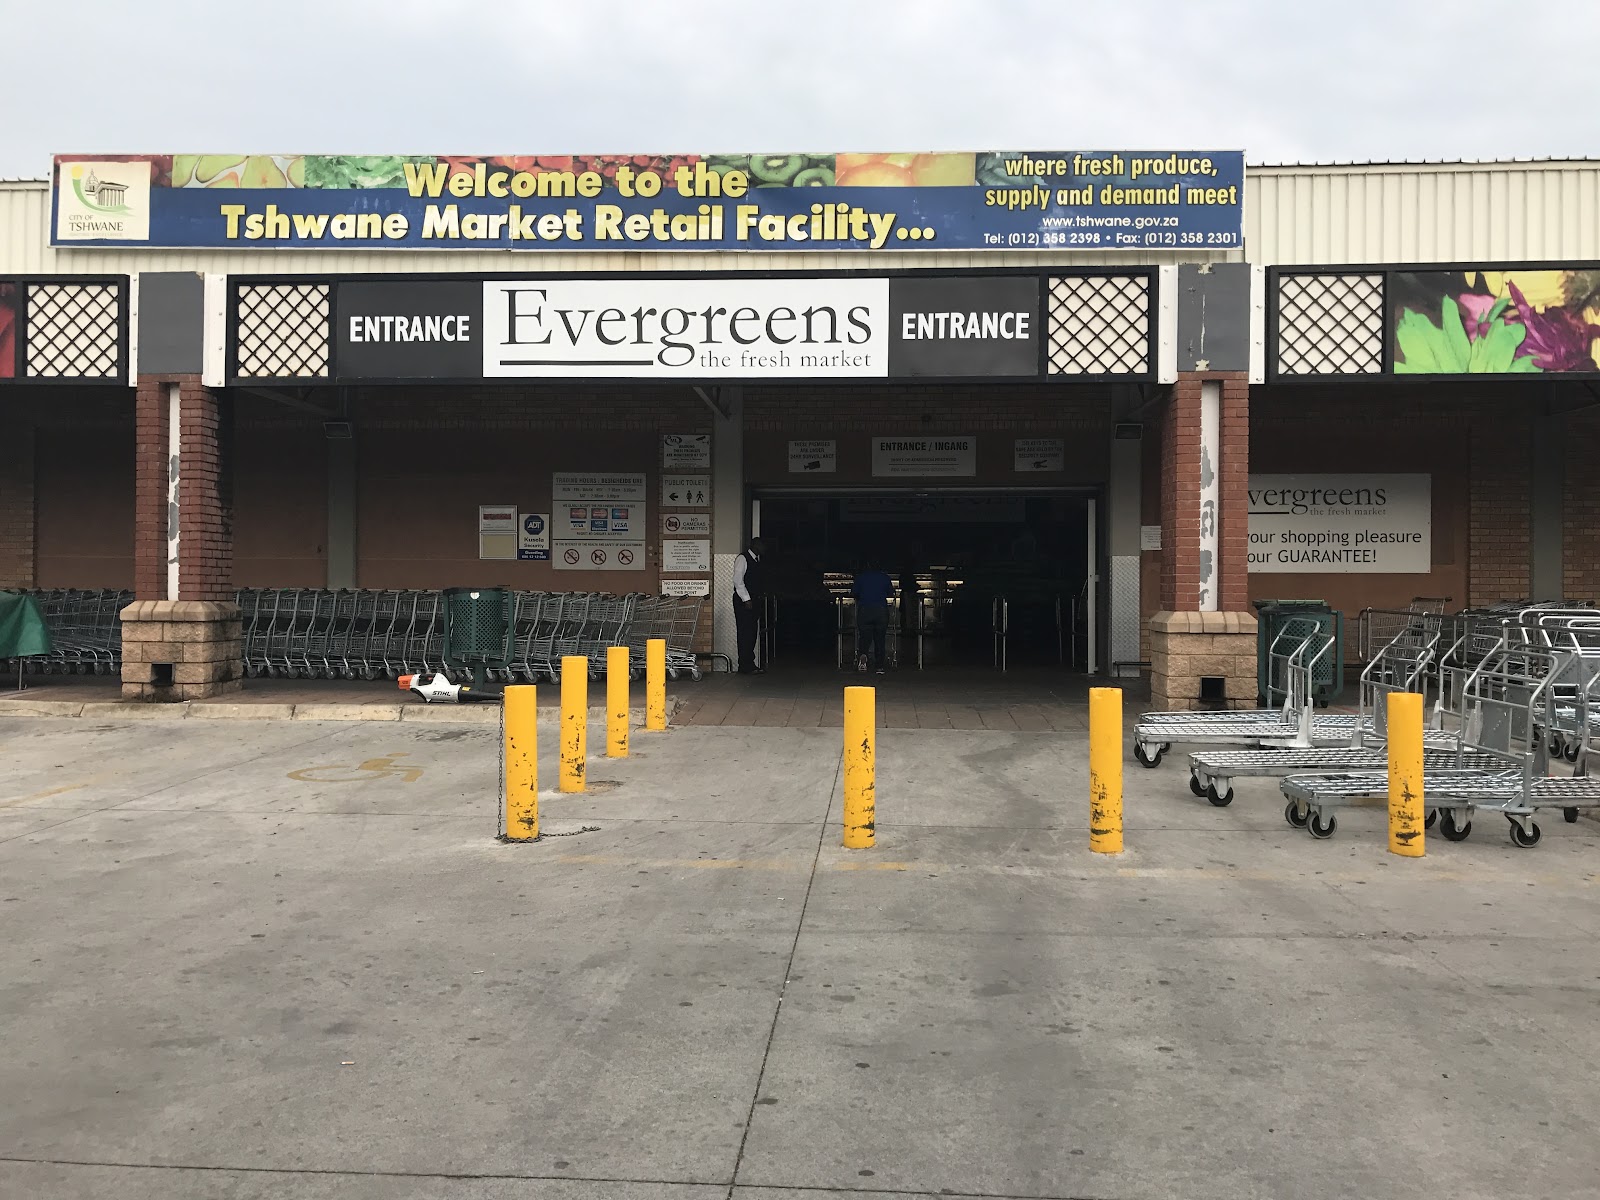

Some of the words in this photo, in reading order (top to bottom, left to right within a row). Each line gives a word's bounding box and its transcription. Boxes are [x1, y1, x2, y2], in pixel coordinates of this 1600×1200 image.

[1005, 155, 1067, 176] where
[1073, 154, 1125, 176] fresh
[1131, 155, 1218, 180] produce,
[403, 162, 603, 198] Welcome
[616, 166, 662, 198] to
[674, 161, 748, 198] the
[985, 184, 1051, 210] supply
[1056, 184, 1093, 206] and
[1100, 184, 1180, 205] demand
[1187, 184, 1237, 205] meet
[68, 222, 124, 232] TSHWANE
[220, 203, 409, 240] Tshwane
[422, 204, 583, 241] Market
[595, 204, 723, 241] Retail
[736, 202, 936, 249] Facility...
[1042, 215, 1179, 229] www.tshwane.gov.za
[984, 233, 1005, 245] Tel:
[1008, 233, 1040, 245] (012)
[1043, 233, 1066, 245] 358
[1069, 233, 1101, 245] 2398
[1116, 233, 1141, 245] Fax:
[1144, 233, 1177, 245] (012)
[1180, 233, 1204, 245] 358
[1207, 233, 1237, 245] 2301
[349, 315, 470, 342] ENTRANCE
[499, 288, 872, 367] Evergreens
[901, 311, 1030, 340] ENTRANCE
[700, 350, 731, 368] the
[740, 349, 791, 368] fresh
[800, 350, 872, 368] market
[880, 442, 927, 451] ENTRANCE
[935, 442, 968, 451] INGANG
[1248, 487, 1387, 515] vergreens
[1310, 507, 1324, 516] the
[1328, 507, 1351, 516] fresh
[1354, 507, 1387, 516] market
[1281, 530, 1349, 546] shopping
[1355, 530, 1422, 546] pleasure
[1278, 550, 1377, 563] GUARANTEE!
